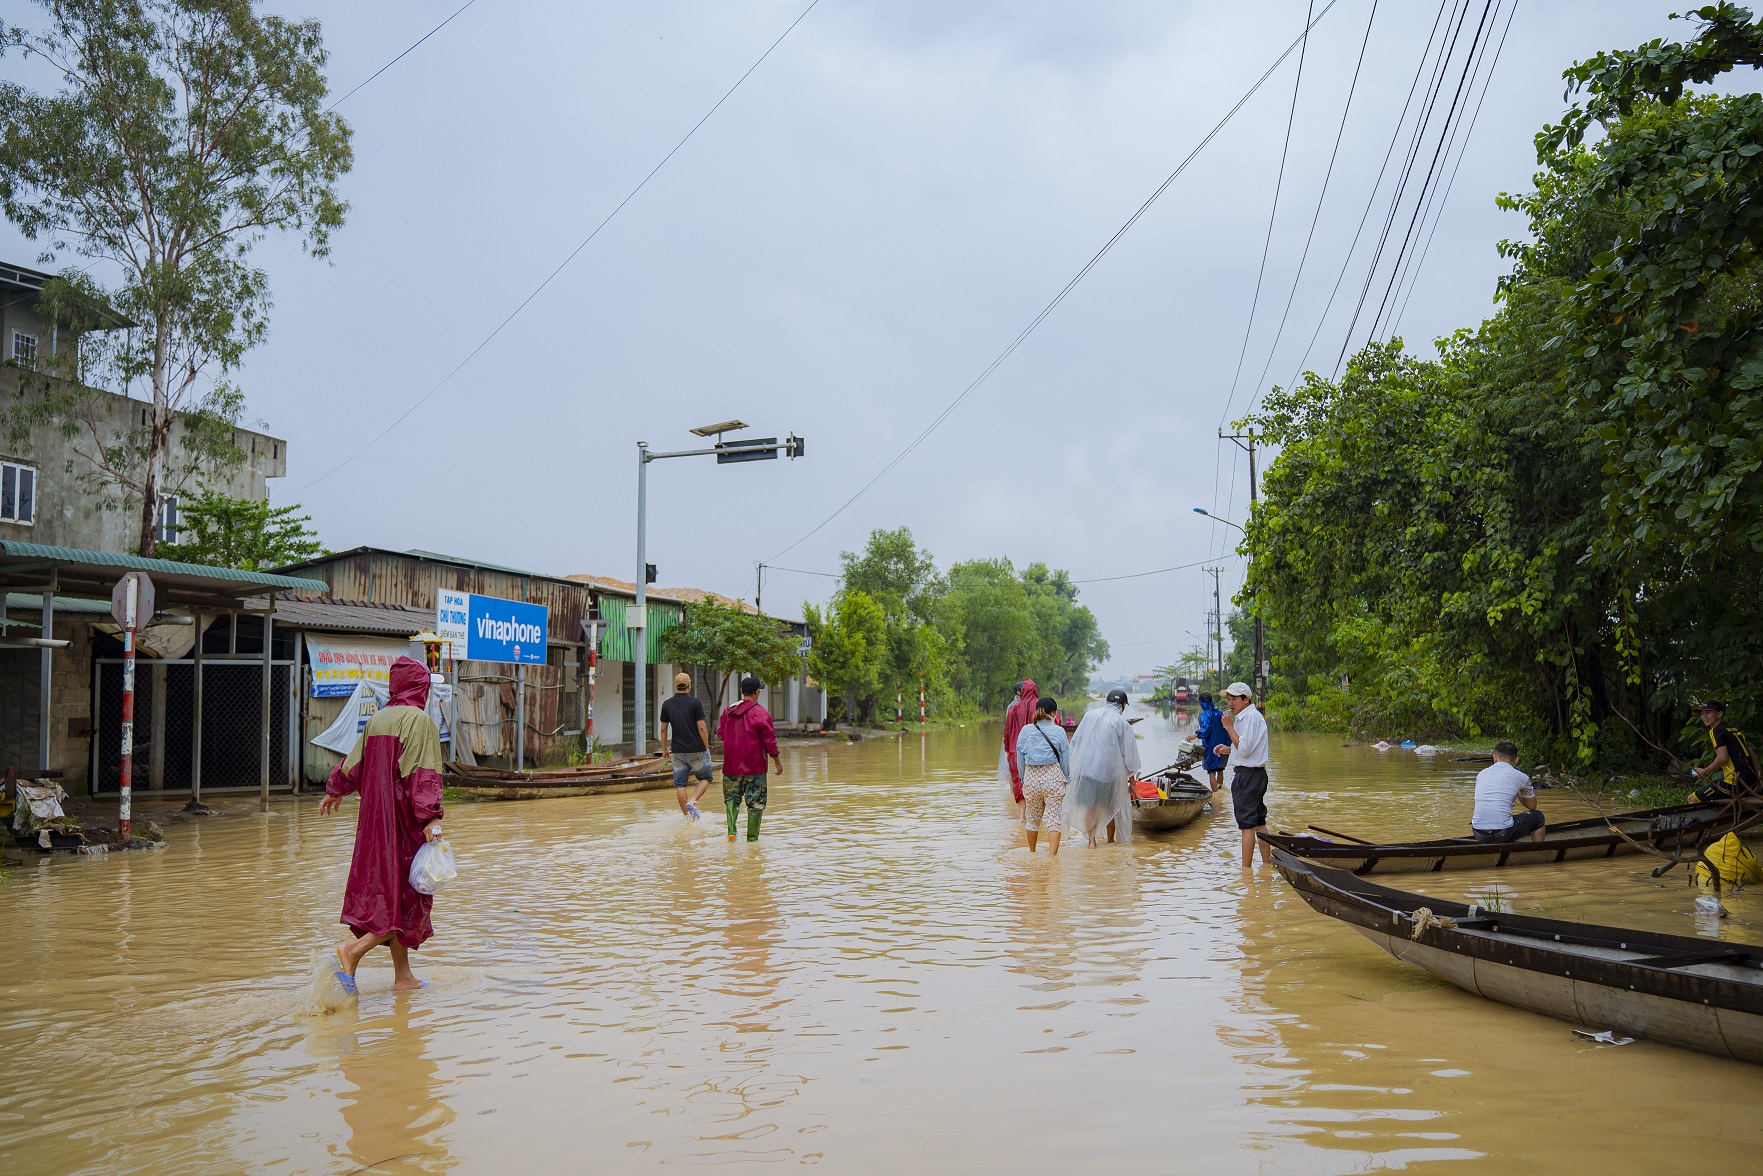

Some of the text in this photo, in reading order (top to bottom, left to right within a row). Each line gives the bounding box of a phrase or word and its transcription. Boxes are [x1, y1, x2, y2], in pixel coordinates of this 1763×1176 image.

[477, 613, 541, 646] vinaphone
[369, 655, 377, 666] XE
[1703, 787, 1716, 797] 17
